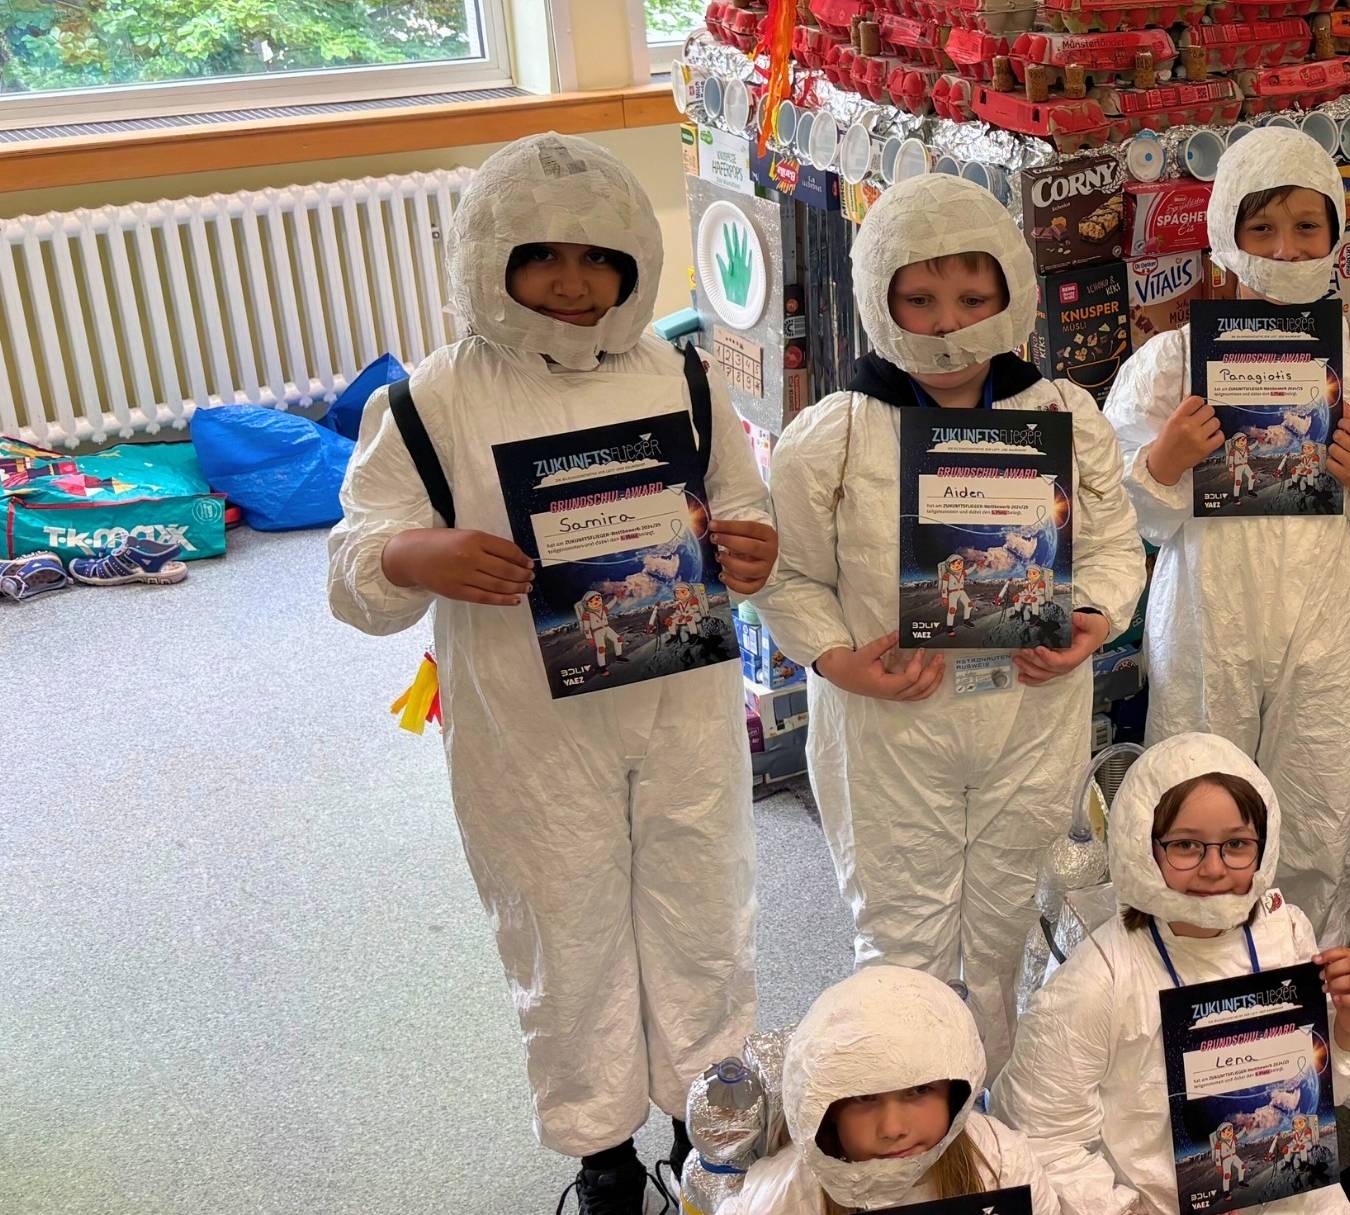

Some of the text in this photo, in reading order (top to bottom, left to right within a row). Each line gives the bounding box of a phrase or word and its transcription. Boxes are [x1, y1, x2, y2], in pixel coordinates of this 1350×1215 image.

[1032, 161, 1117, 208] CORNY
[1156, 210, 1208, 227] SPAGHET
[1135, 258, 1193, 305] VITALIS
[1060, 301, 1120, 323] KNUSPER
[1169, 305, 1190, 324] MÜS
[1062, 321, 1088, 333] MÜSLI
[1222, 353, 1311, 363] GRUNDSCHUL-AWARD
[1220, 368, 1292, 384] Panagiotis
[937, 466, 1038, 479] GRUNDSCHUL-AWARD
[550, 481, 664, 515] GRUNDSCHUL-AWARD
[943, 486, 985, 499] Aiden
[559, 511, 636, 534] Samira
[912, 631, 932, 639] YAEZ
[562, 676, 585, 687] YAEZ
[1200, 1023, 1296, 1052] GRUNDSCHUL-AWARD
[1216, 1054, 1258, 1069] Lena
[1192, 1201, 1210, 1210] YAEZ
